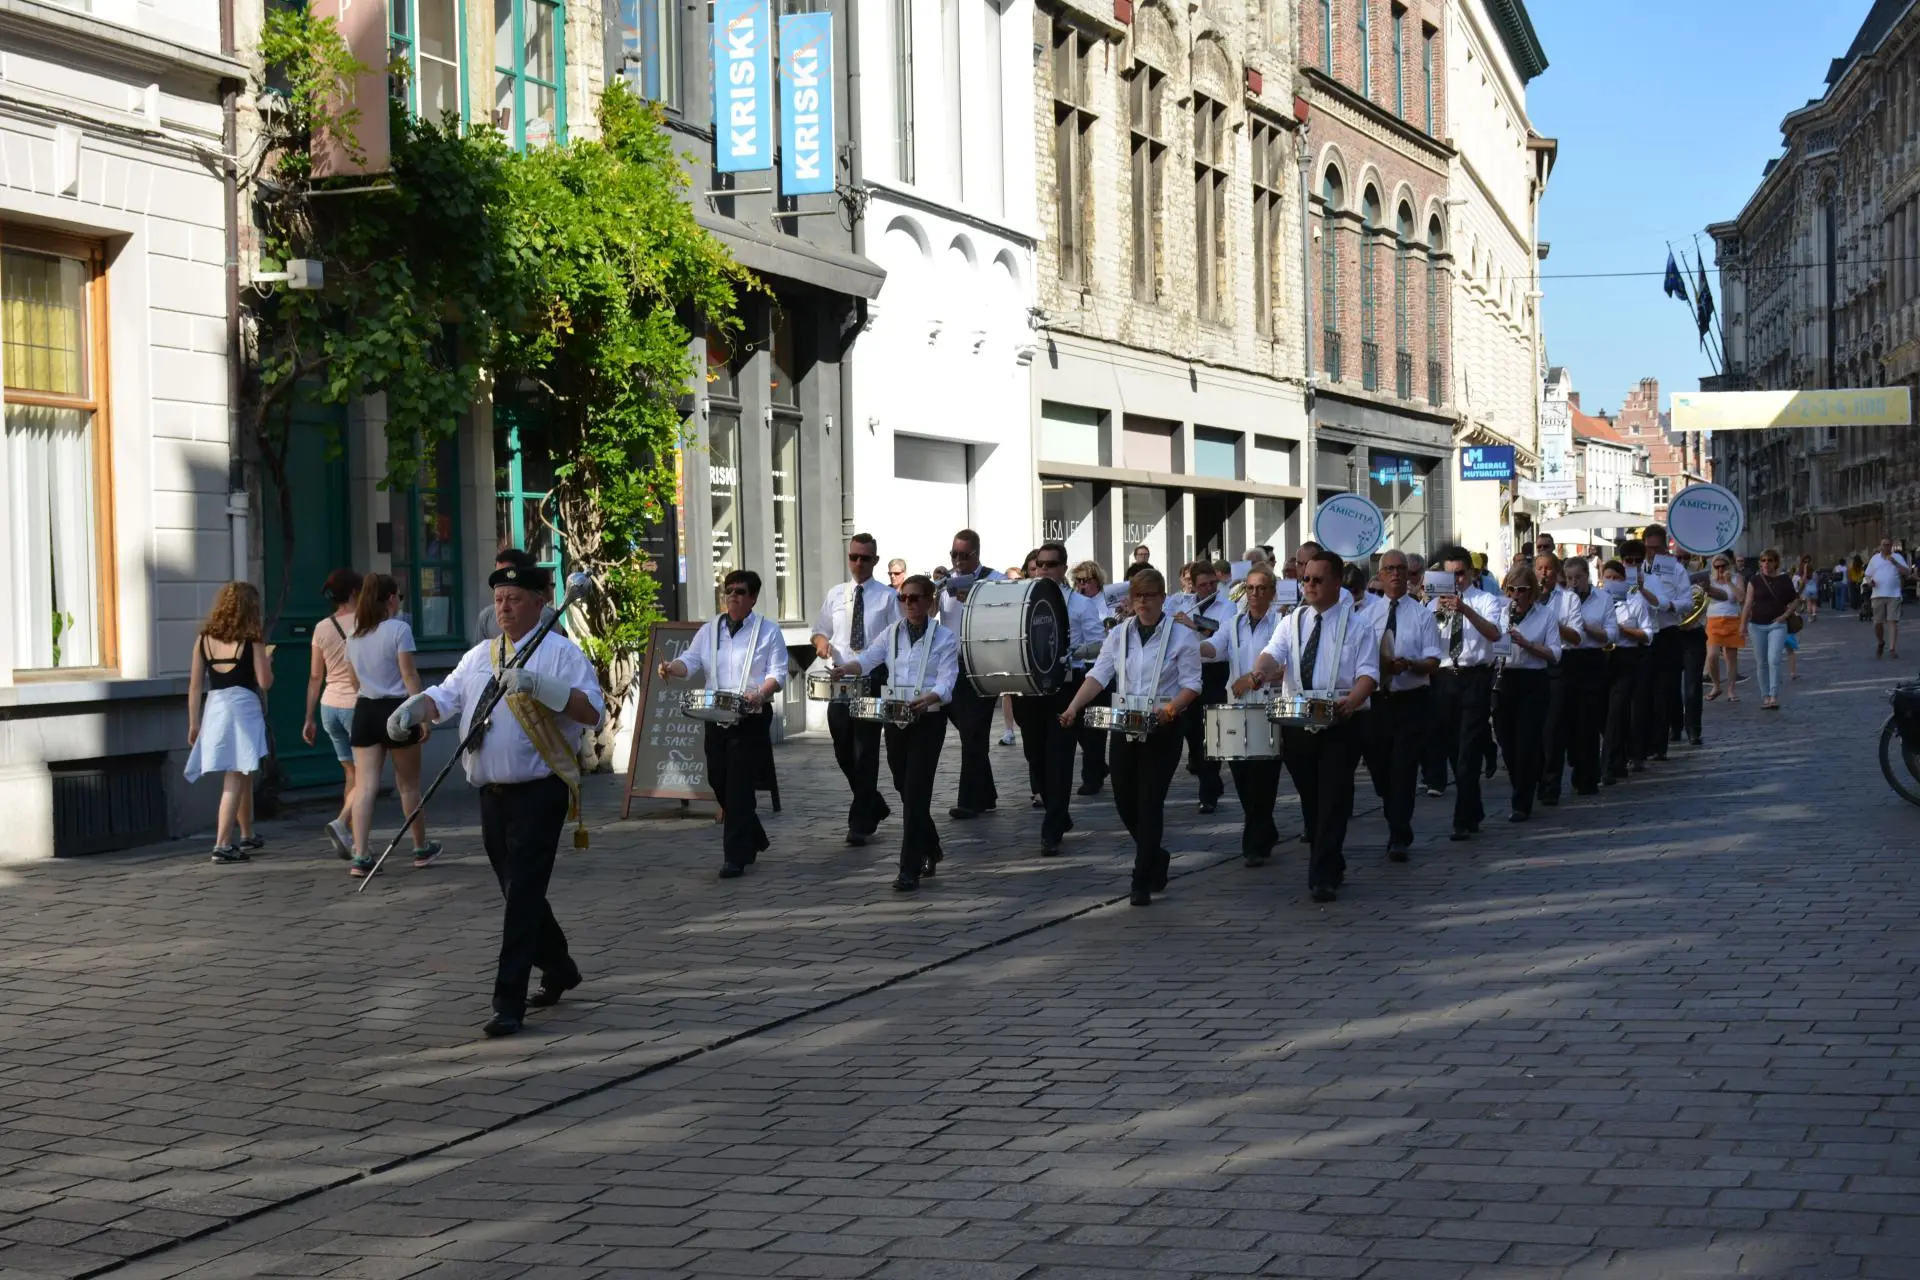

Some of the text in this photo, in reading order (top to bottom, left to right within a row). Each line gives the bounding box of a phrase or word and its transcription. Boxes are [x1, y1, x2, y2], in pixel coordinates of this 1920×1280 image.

[728, 17, 757, 157] KRISKI
[793, 48, 820, 180] KRISKI
[1473, 461, 1507, 470] LIBERALE
[709, 465, 737, 486] RISKI
[1463, 469, 1511, 478] MUTUALITEIT
[1679, 500, 1729, 513] AMICITIA
[1329, 503, 1374, 524] AMICITIA
[1123, 523, 1141, 544] LISA
[665, 723, 702, 735] DUCK
[663, 736, 696, 747] SAKE
[656, 760, 704, 773] GARDEN
